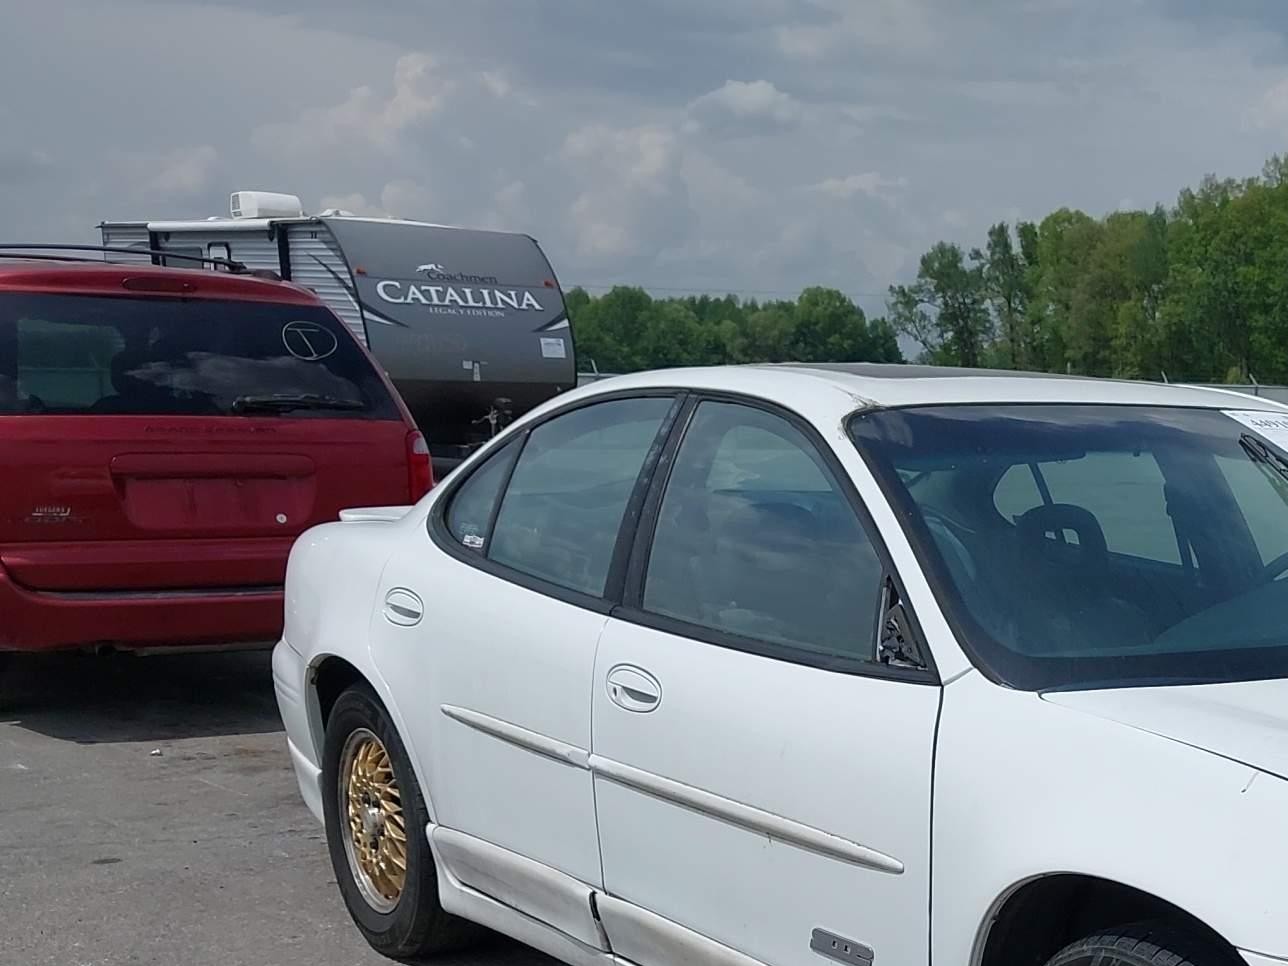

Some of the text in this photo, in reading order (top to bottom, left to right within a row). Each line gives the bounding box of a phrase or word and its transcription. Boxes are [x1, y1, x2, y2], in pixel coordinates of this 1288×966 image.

[426, 270, 499, 285] Coachmen
[375, 280, 545, 312] CATALINA
[467, 308, 505, 318] EDITION
